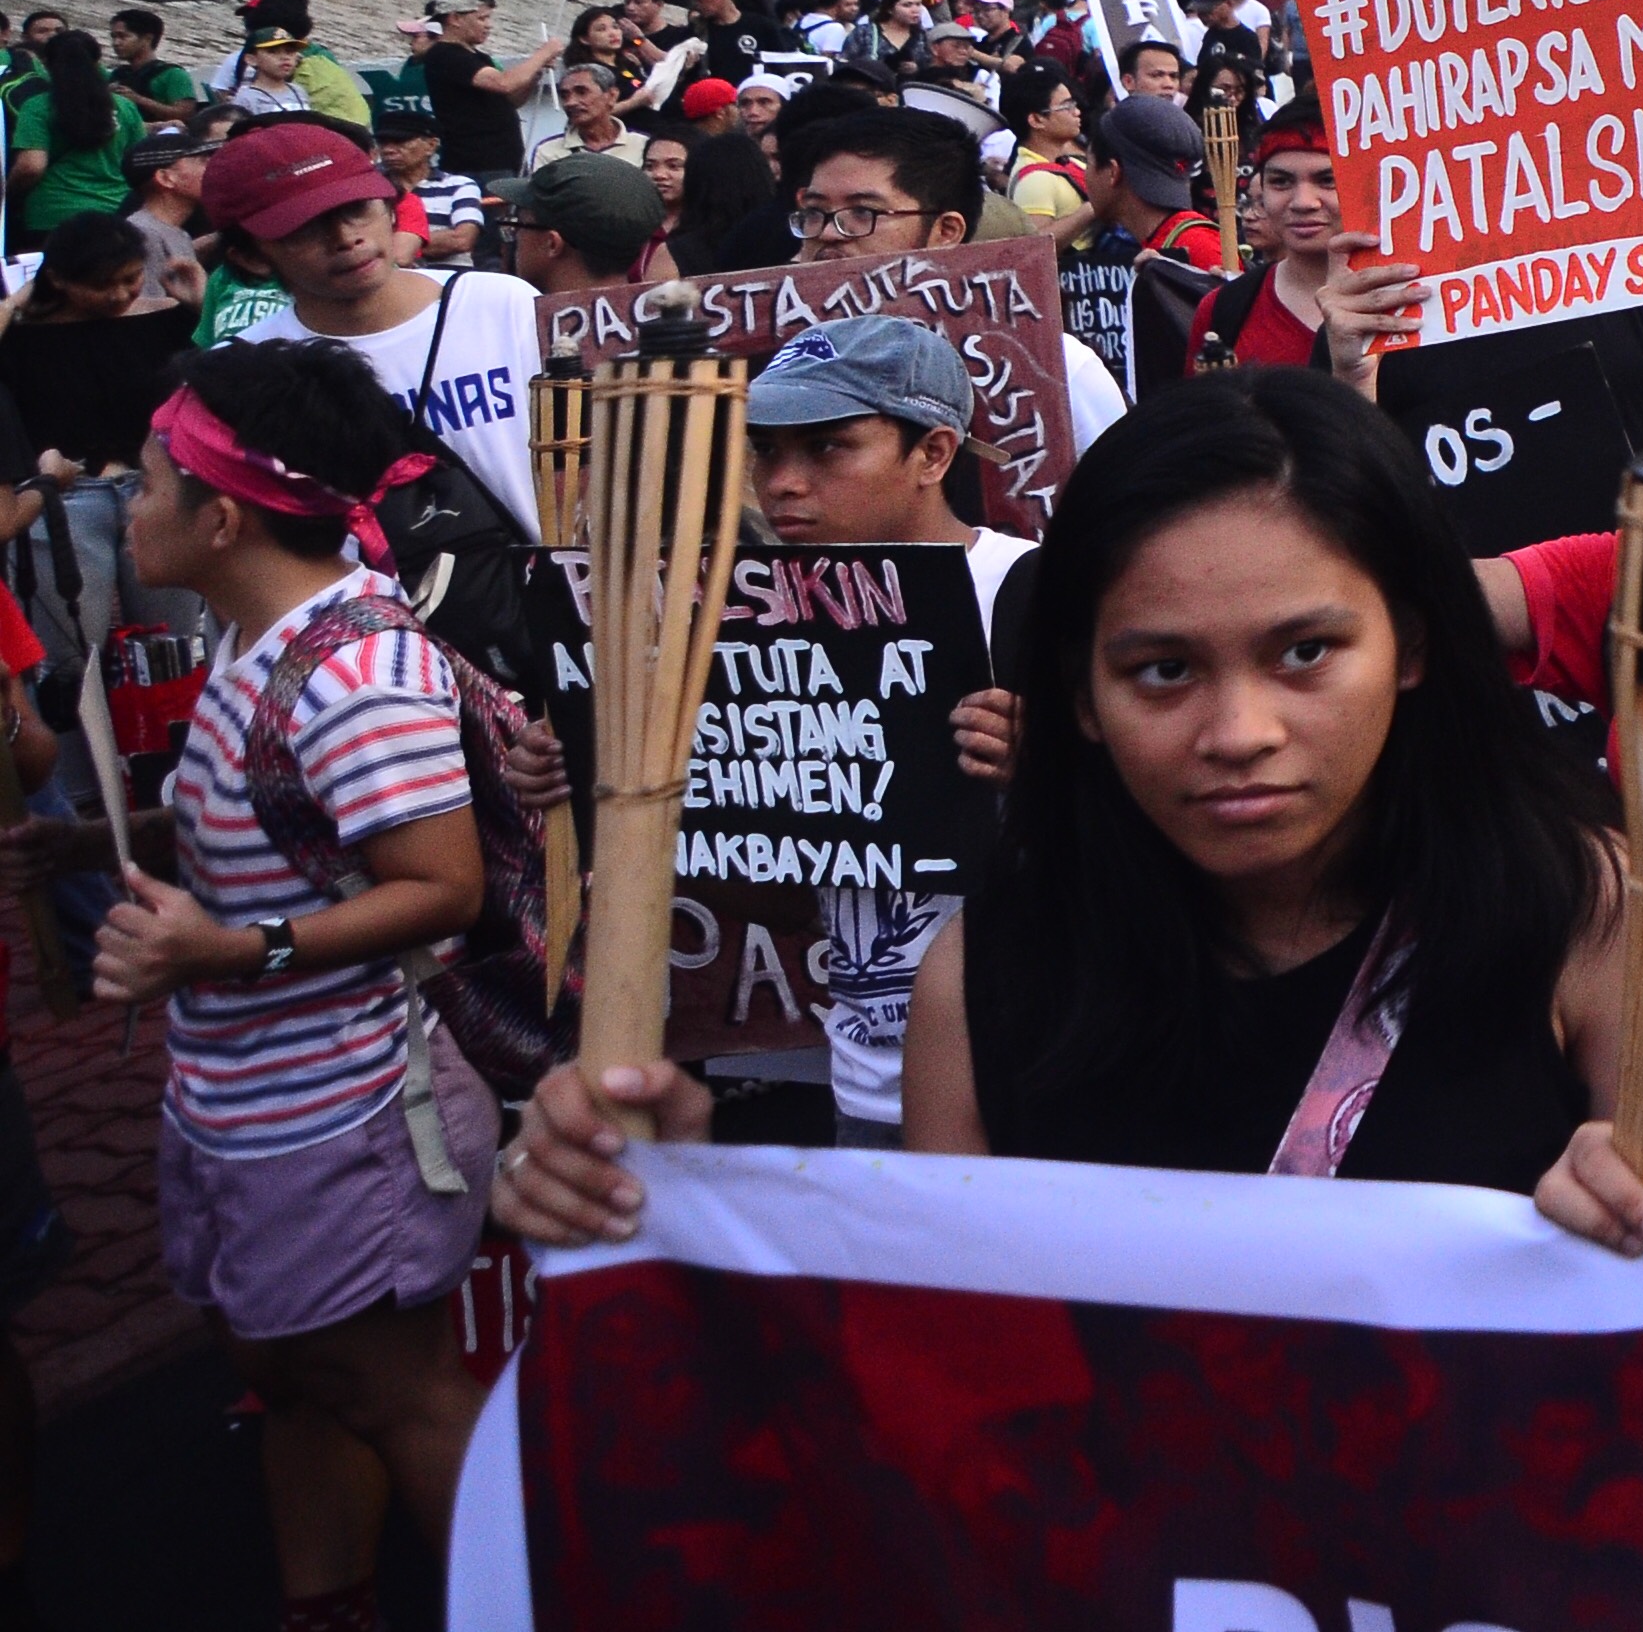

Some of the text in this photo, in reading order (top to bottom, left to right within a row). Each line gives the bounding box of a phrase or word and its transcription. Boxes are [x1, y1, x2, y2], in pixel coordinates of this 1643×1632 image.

[1331, 37, 1530, 158] PAHIRAP
[1533, 27, 1606, 107] SA
[552, 275, 820, 346] PASTA
[907, 268, 1043, 329] TUTA
[1439, 246, 1618, 335] PANDAY
[712, 638, 934, 700] TUTA AT
